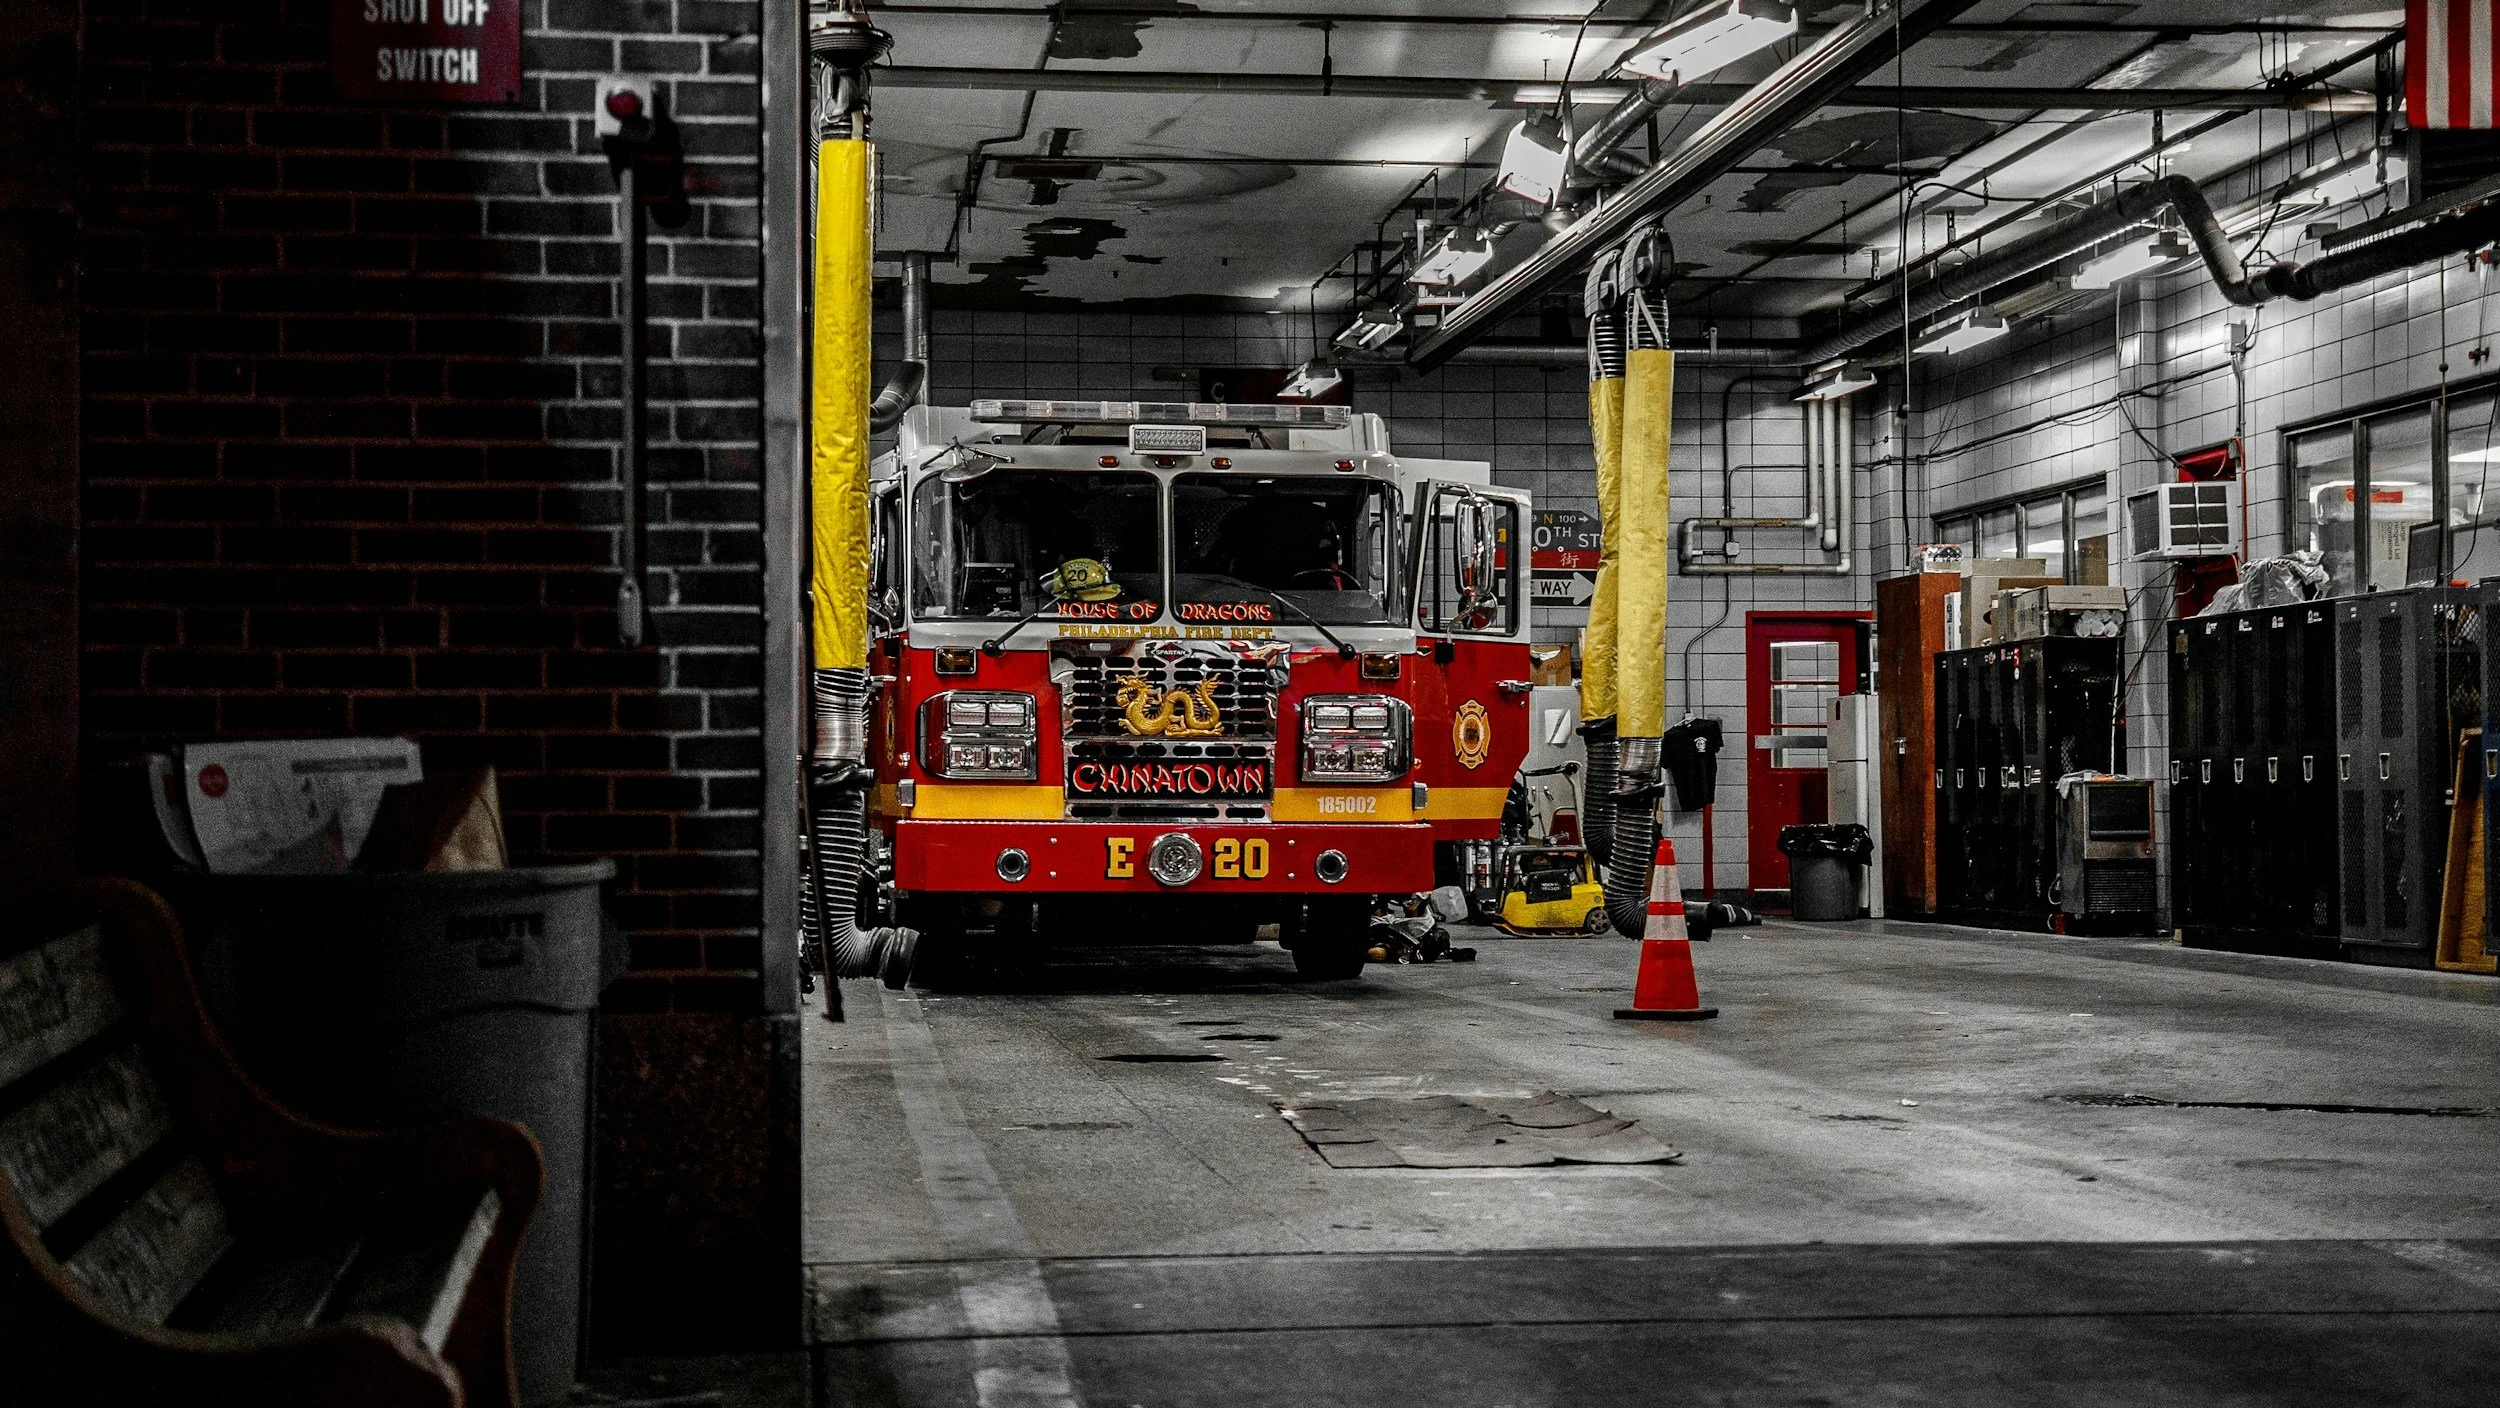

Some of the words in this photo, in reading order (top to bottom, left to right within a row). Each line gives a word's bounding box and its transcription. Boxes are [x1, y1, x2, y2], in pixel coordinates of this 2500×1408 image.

[363, 0, 428, 24] SHUT
[443, 0, 489, 26] OFF
[377, 47, 478, 84] SWITCH
[1543, 514, 1553, 524] N
[1559, 515, 1576, 523] 100
[1534, 526, 1571, 547] 0TH
[1578, 533, 1600, 548] ST
[1067, 569, 1087, 582] 20
[1540, 581, 1571, 595] WAY
[1057, 602, 1119, 619] HOUSE
[1129, 602, 1158, 619] OF
[1180, 602, 1274, 621] DRAGONS
[1058, 624, 1179, 638] PHILADELPHIA
[1185, 626, 1223, 639] FIRE
[1231, 627, 1277, 640] DEPT.
[1072, 763, 1265, 794] CHINATOWN
[1317, 796, 1377, 814] 185002
[1106, 837, 1134, 878] E
[1213, 837, 1269, 878] 20
